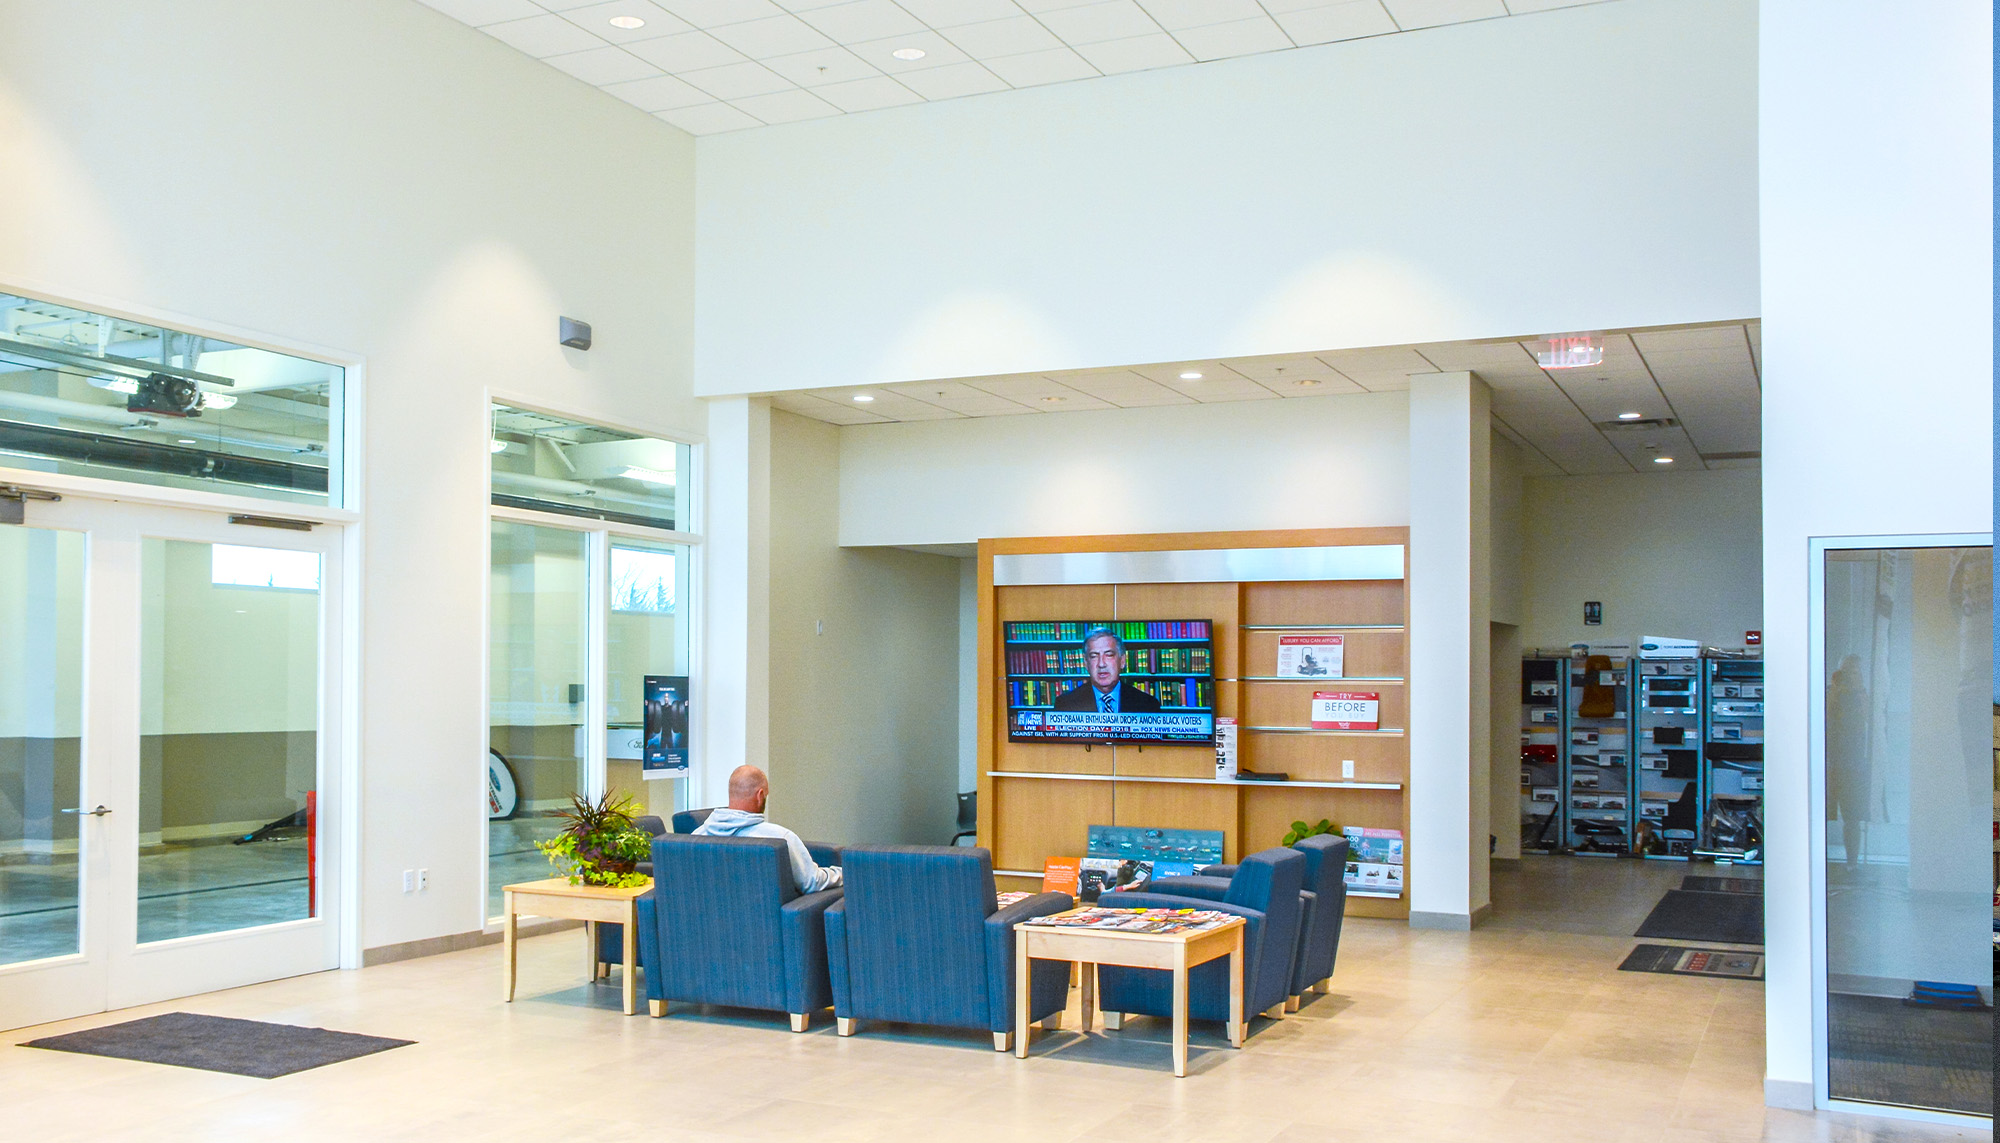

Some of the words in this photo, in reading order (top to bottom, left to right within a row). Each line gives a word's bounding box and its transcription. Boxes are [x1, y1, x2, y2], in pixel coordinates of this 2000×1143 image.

[1325, 702, 1366, 712] BEFORE
[1050, 714, 1084, 723] POST-OBAMA
[1085, 715, 1119, 724] ENTHUSIASM
[1120, 715, 1138, 724] DROPS
[1139, 716, 1161, 724] AMONG
[1162, 716, 1180, 725] BLACK
[1181, 716, 1202, 725] VOTERS
